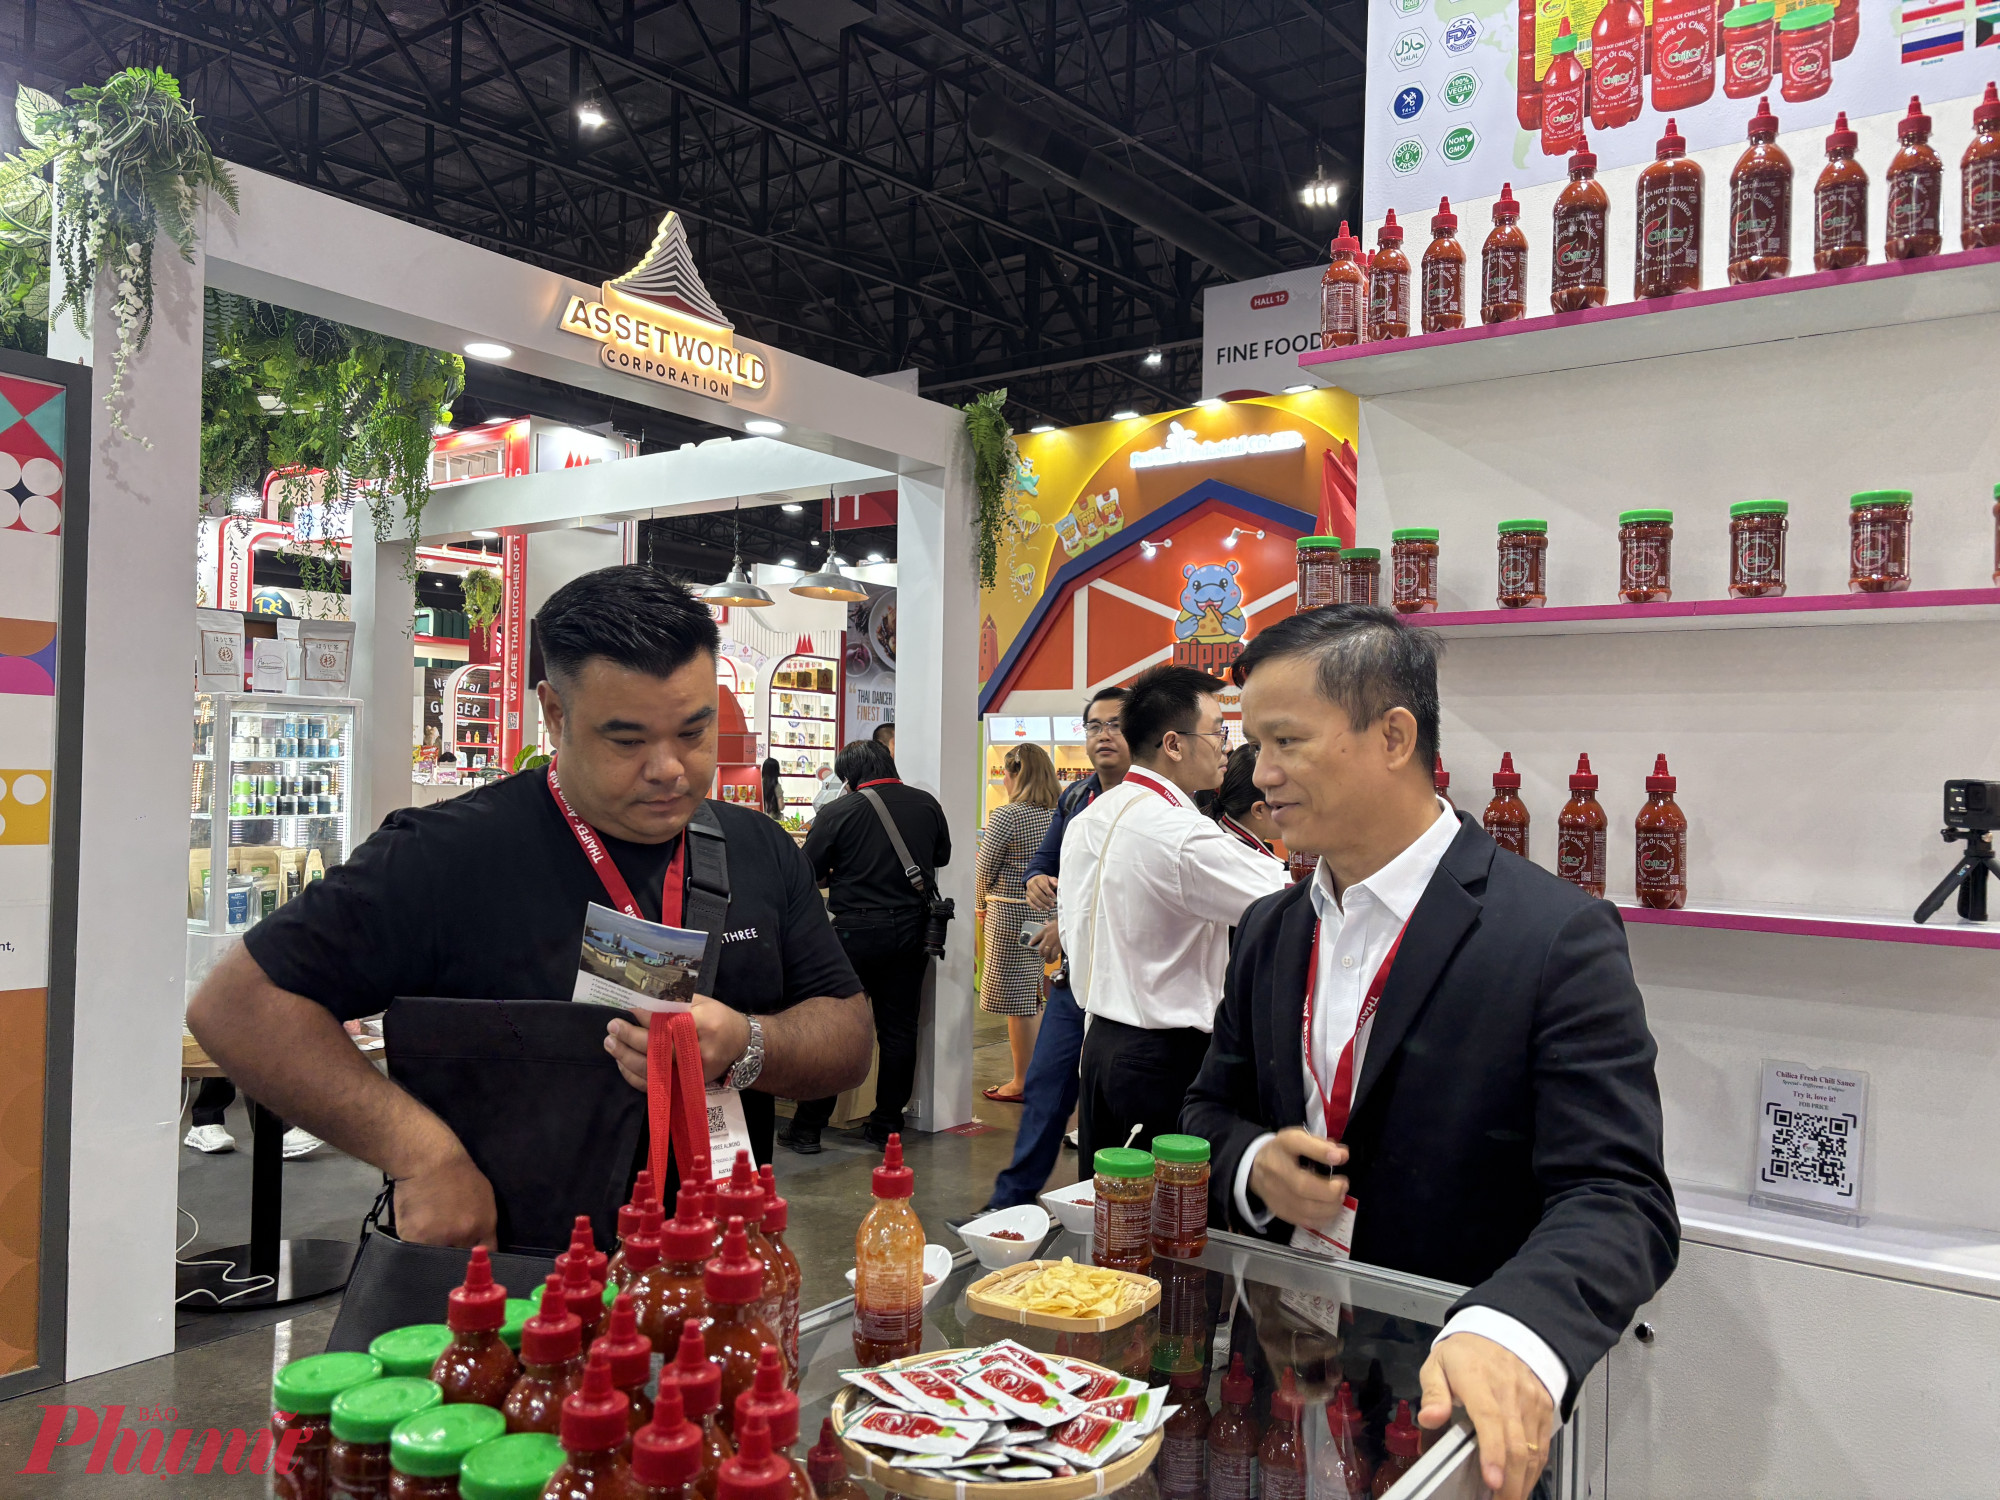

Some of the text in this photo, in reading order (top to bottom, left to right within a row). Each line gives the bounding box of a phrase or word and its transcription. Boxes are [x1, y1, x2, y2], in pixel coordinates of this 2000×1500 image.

[1446, 25, 1477, 45] FDA
[1400, 53, 1419, 63] HALAL
[1448, 84, 1473, 96] VEGAN
[1451, 77, 1470, 87] 100%
[1448, 136, 1465, 146] NON
[1448, 145, 1466, 154] GMO
[1396, 142, 1419, 158] GLUTEN
[1398, 160, 1416, 169] FREE
[1654, 188, 1664, 196] HOT
[1670, 197, 1692, 217] Chilica
[1254, 294, 1285, 306] HALL 12
[570, 300, 766, 384] ASSETWORLD
[1216, 332, 1321, 365] FINE FOOD
[606, 350, 729, 397] CORPORATION
[513, 543, 520, 562] OF
[229, 562, 239, 598] WORLD
[511, 564, 520, 619] KITCHEN
[511, 621, 519, 651] THAI
[510, 653, 518, 679] ARE
[510, 681, 517, 702] WE
[858, 689, 870, 703] THAI
[857, 705, 880, 721] FINEST
[574, 823, 604, 864] THAIFEX
[1776, 1070, 1855, 1088] Chilica Fresh Chili Sauce
[1793, 1090, 1804, 1099] Try
[1814, 1093, 1827, 1102] love
[1829, 1095, 1837, 1103] it!
[724, 1141, 741, 1149] ALMOND
